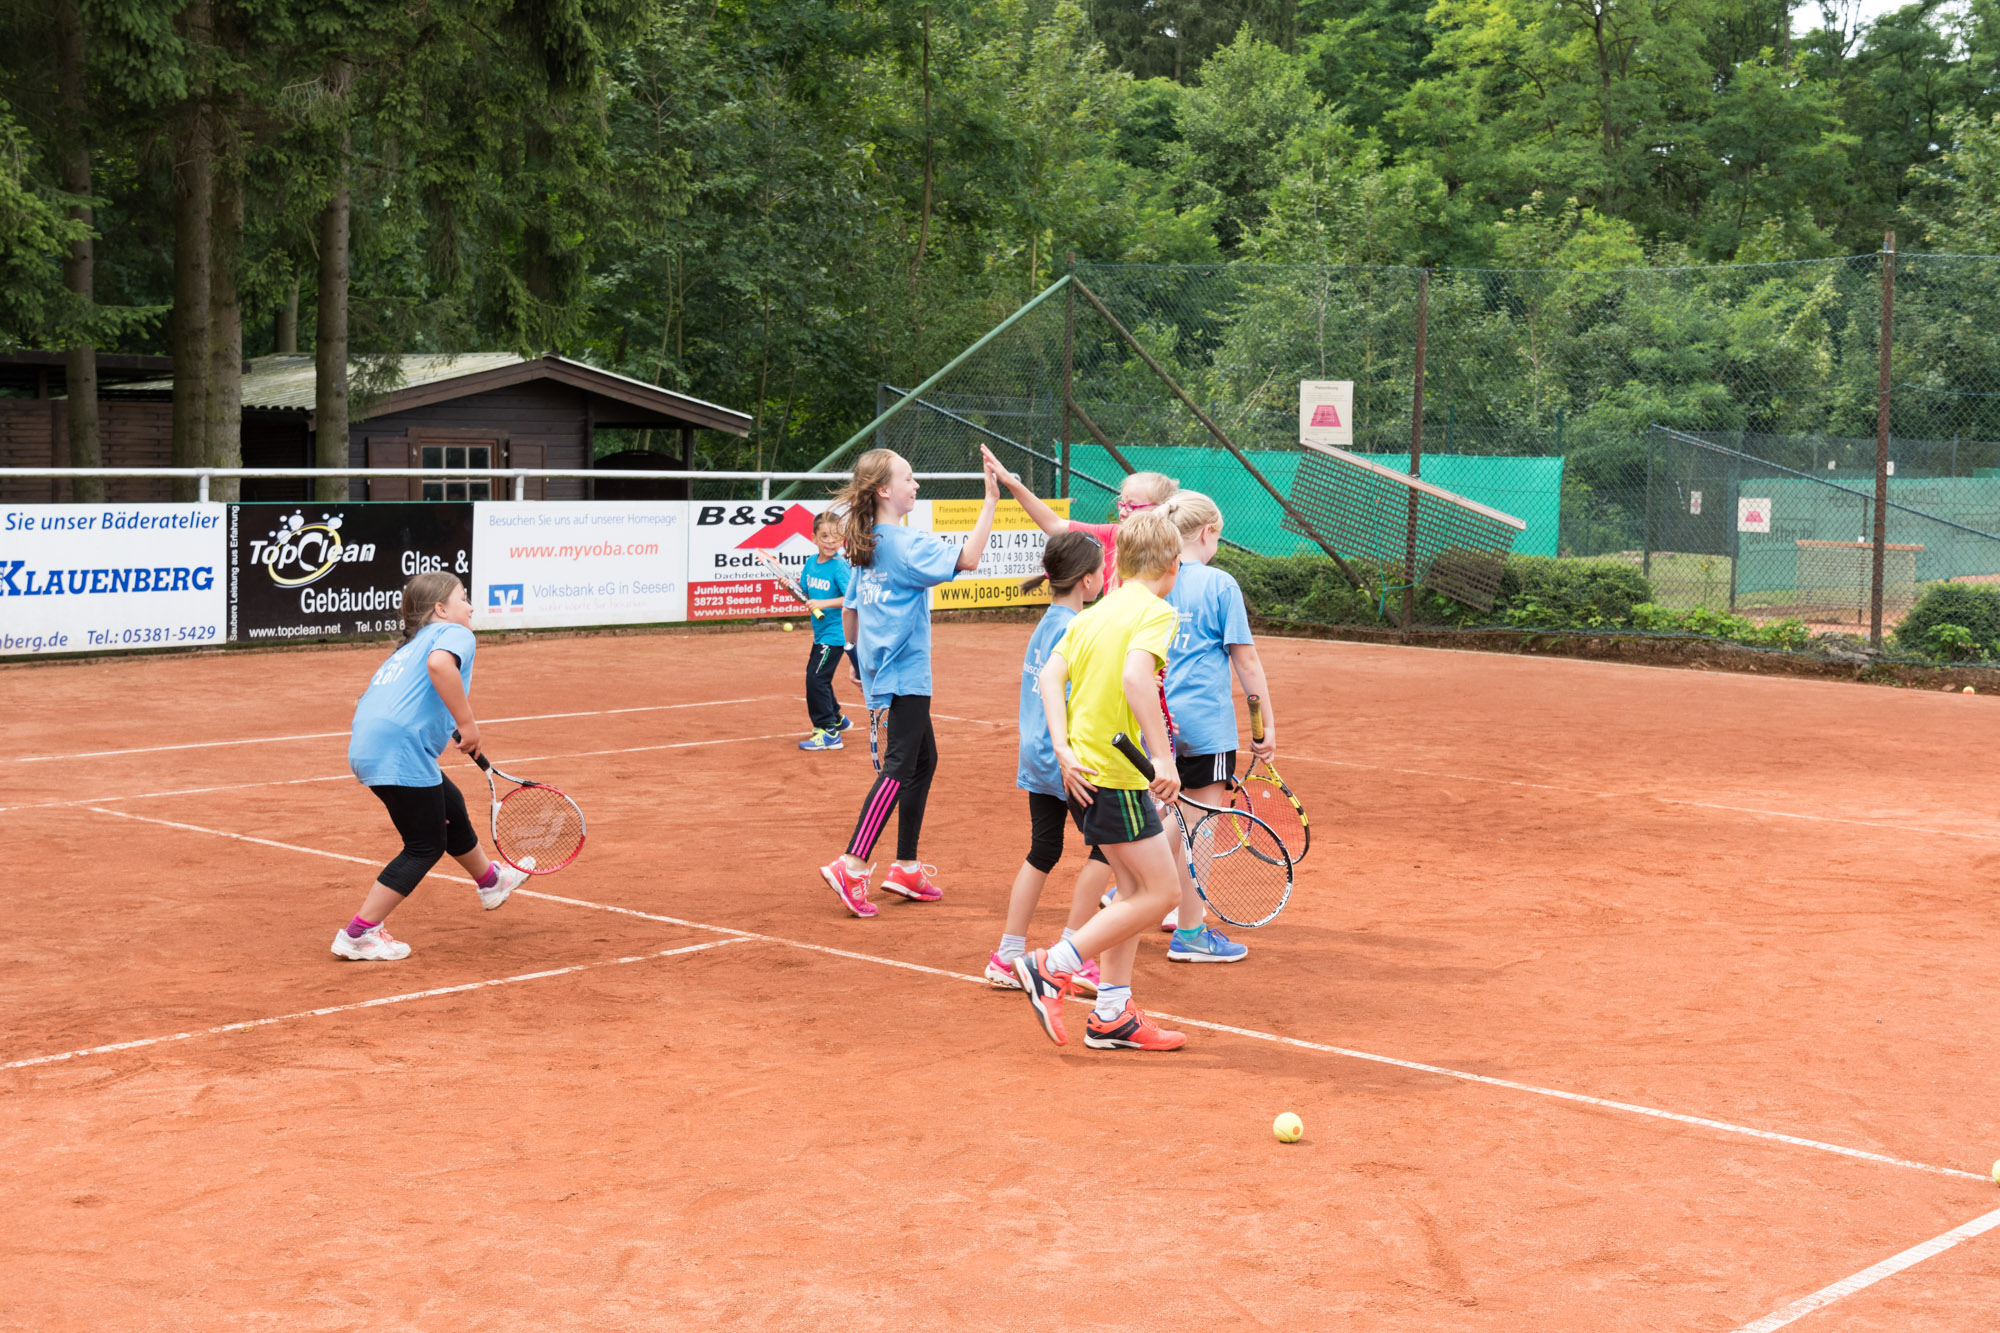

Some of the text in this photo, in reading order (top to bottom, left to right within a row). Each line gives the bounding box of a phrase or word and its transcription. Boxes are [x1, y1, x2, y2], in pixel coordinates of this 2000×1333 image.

[5, 511, 220, 531] Sie unser Bäderatelier
[489, 513, 677, 526] Besuchen Sie uns auf unserer Homepage
[697, 506, 786, 526] B&S
[935, 517, 977, 526] Reparaturarbeite
[509, 540, 659, 561] www.myvoba.com
[990, 534, 1004, 549] 81
[1014, 533, 1028, 548] 49
[1032, 533, 1045, 548] 16
[249, 532, 376, 571] TopClean
[229, 505, 240, 641] Saubere Leistung aus Erfahrung
[401, 550, 469, 576] Glas- &
[1027, 563, 1045, 574] Sees
[0, 560, 214, 596] KLAUENBERG
[810, 576, 830, 591] JAKO
[532, 580, 676, 598] Volksbank eG in Seesen
[694, 584, 754, 596] Junkernfeld
[755, 583, 762, 593] 5
[300, 585, 406, 614] Gebäudere
[694, 597, 724, 607] 38723
[726, 595, 762, 606] Seesen
[0, 625, 216, 652] berg.de Tel.: 05381-5429
[248, 622, 342, 639] www.topclean.net
[355, 621, 373, 633] Tel.
[375, 620, 382, 632] 0
[384, 619, 398, 632] 53
